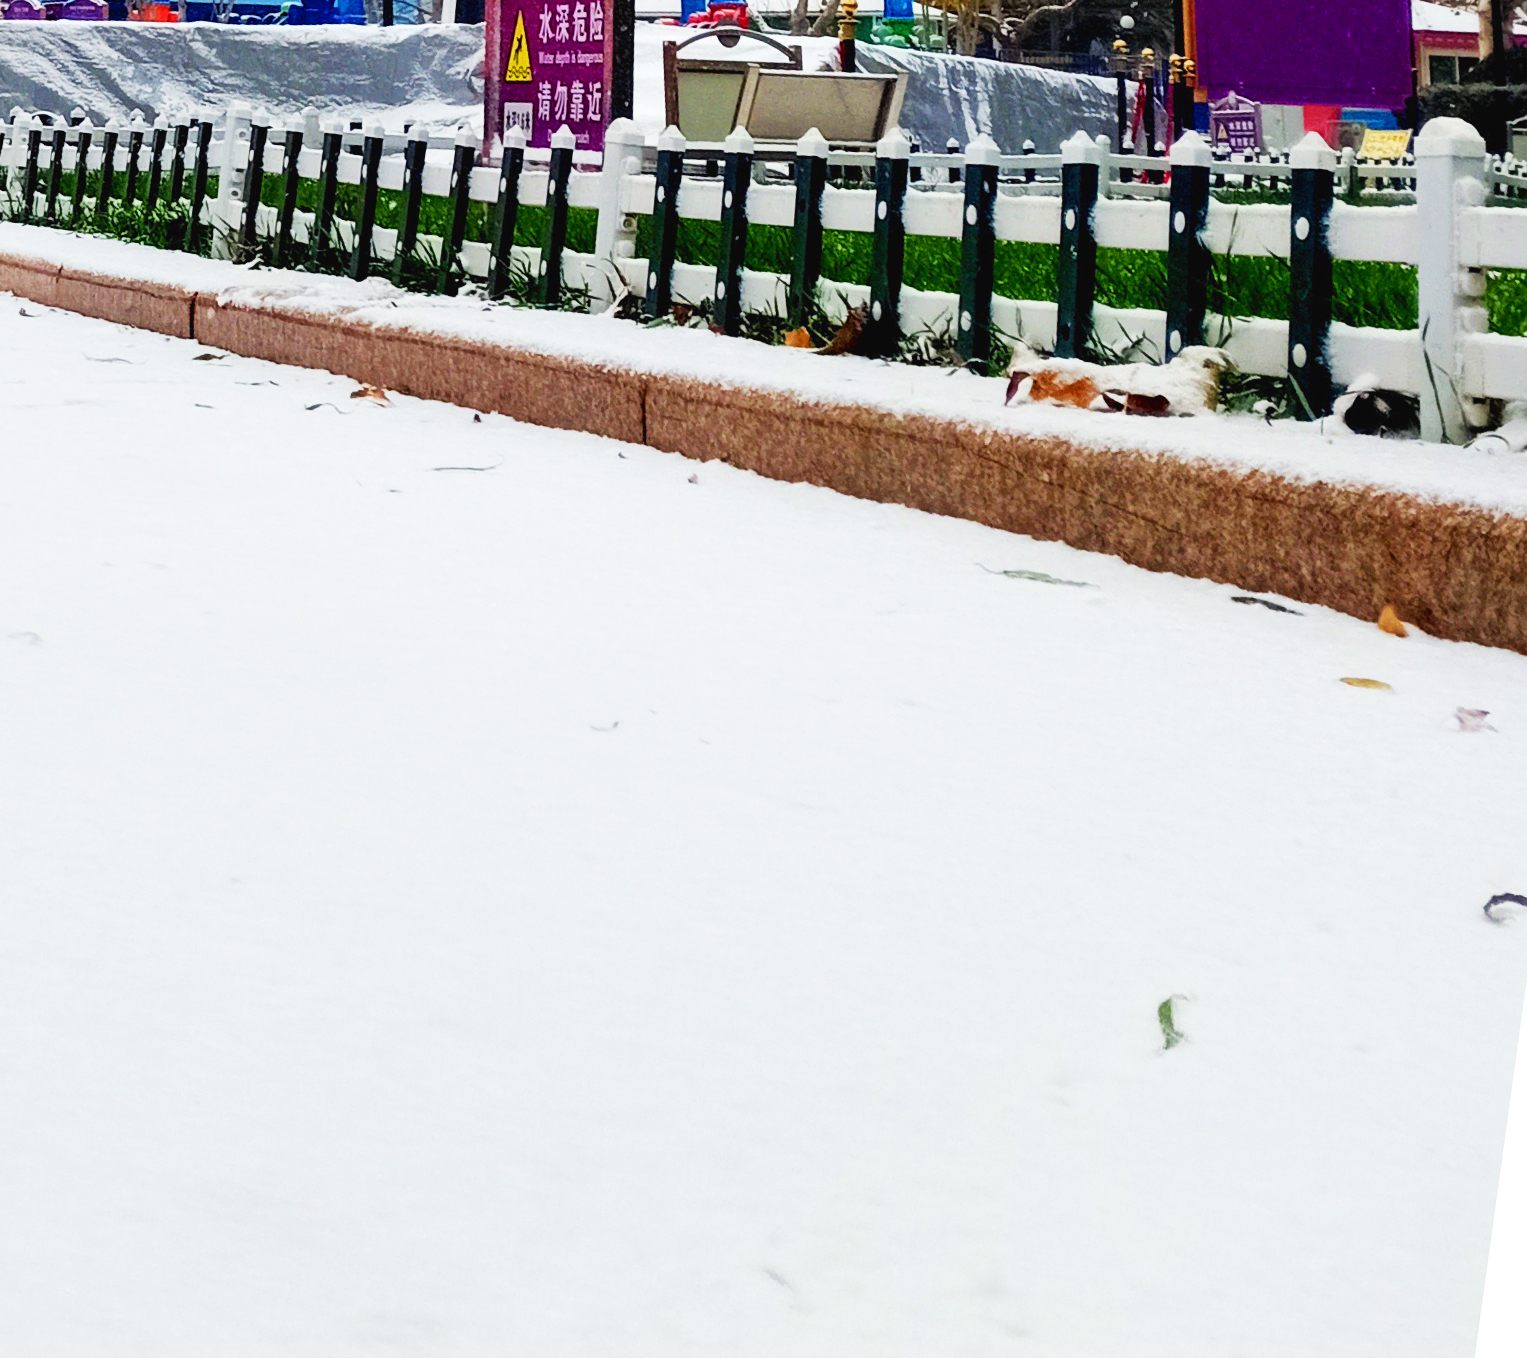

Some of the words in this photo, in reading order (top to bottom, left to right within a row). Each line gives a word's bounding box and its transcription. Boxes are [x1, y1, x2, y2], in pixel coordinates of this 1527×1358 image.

[538, 0, 604, 44] 水深危险
[538, 51, 555, 64] Water
[555, 50, 570, 67] depth
[570, 49, 576, 64] is
[537, 79, 602, 123] 请勿靠近
